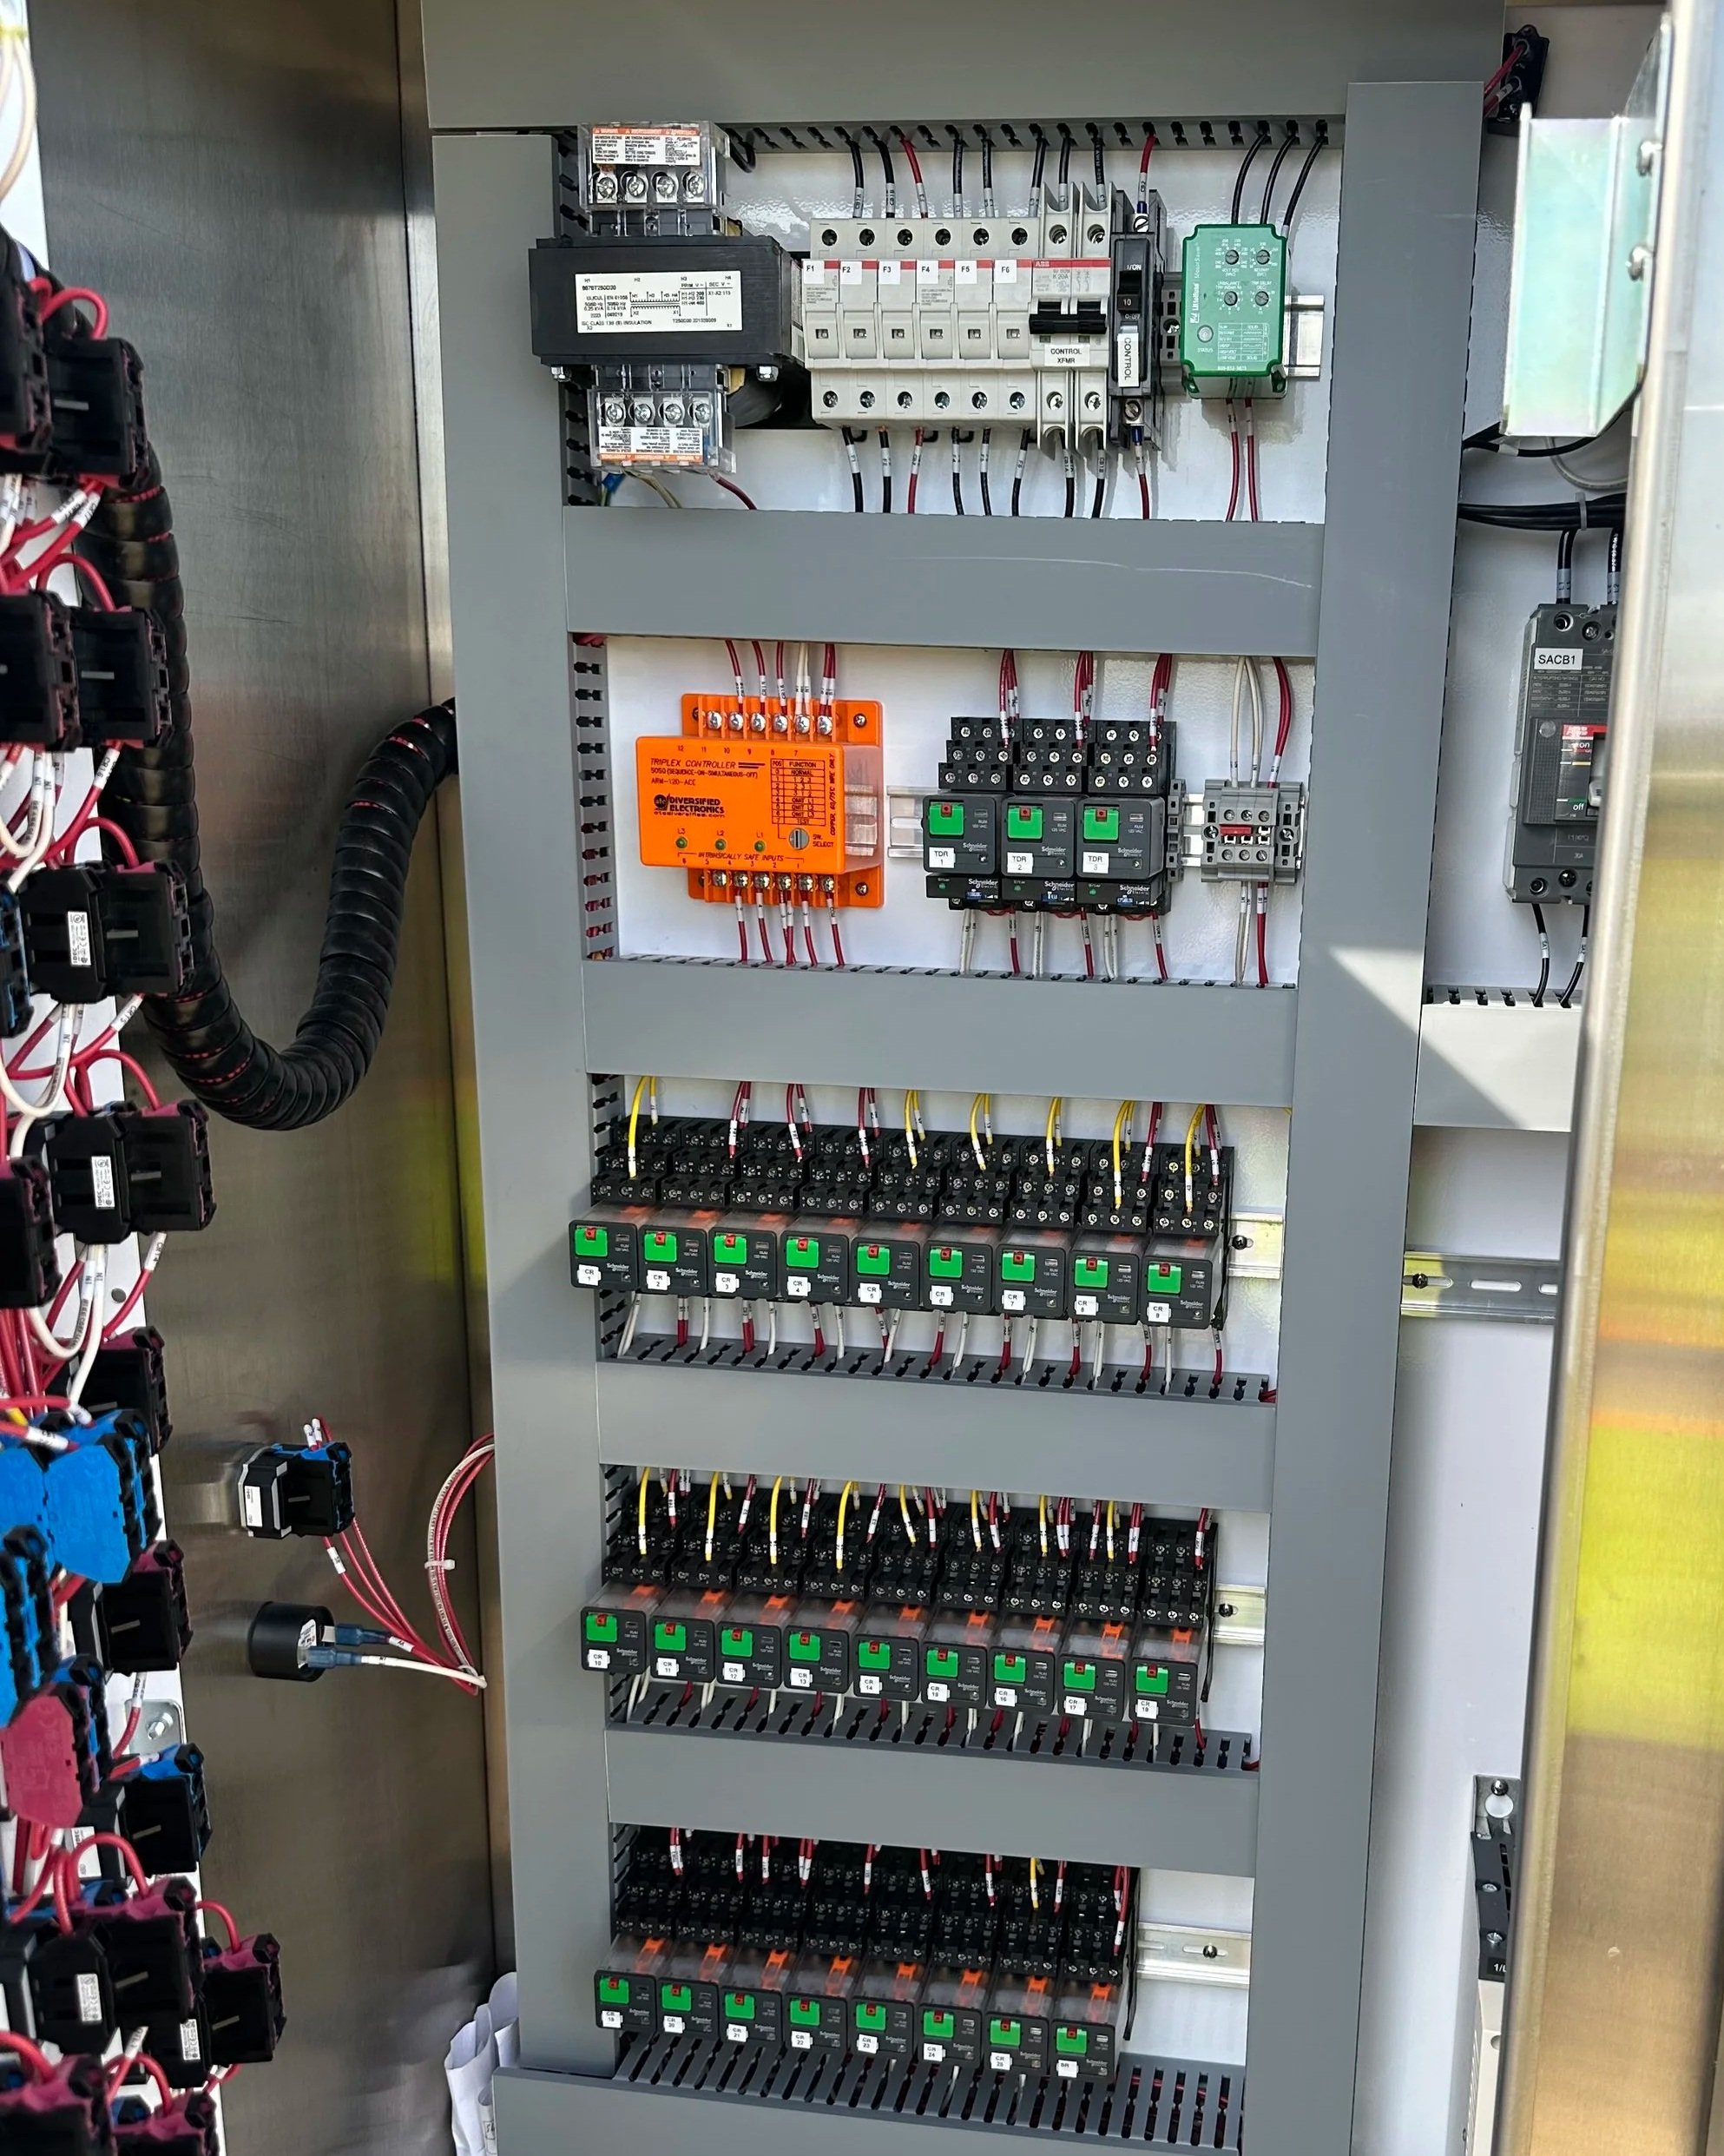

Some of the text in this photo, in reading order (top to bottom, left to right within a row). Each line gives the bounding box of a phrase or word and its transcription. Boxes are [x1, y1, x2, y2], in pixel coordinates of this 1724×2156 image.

[1123, 337, 1133, 381] CONTROL
[1537, 654, 1576, 665] SACB1
[651, 757, 737, 769] TRIPLEX CONTROLLER
[669, 796, 721, 806] DIVERSIFIED
[669, 805, 725, 814] ELECTRONICS
[1572, 802, 1584, 811] off
[968, 878, 999, 889] Schneider
[1044, 881, 1076, 891] Schneider
[1120, 884, 1151, 894] Schneider
[120, 1005, 137, 1024] CR15
